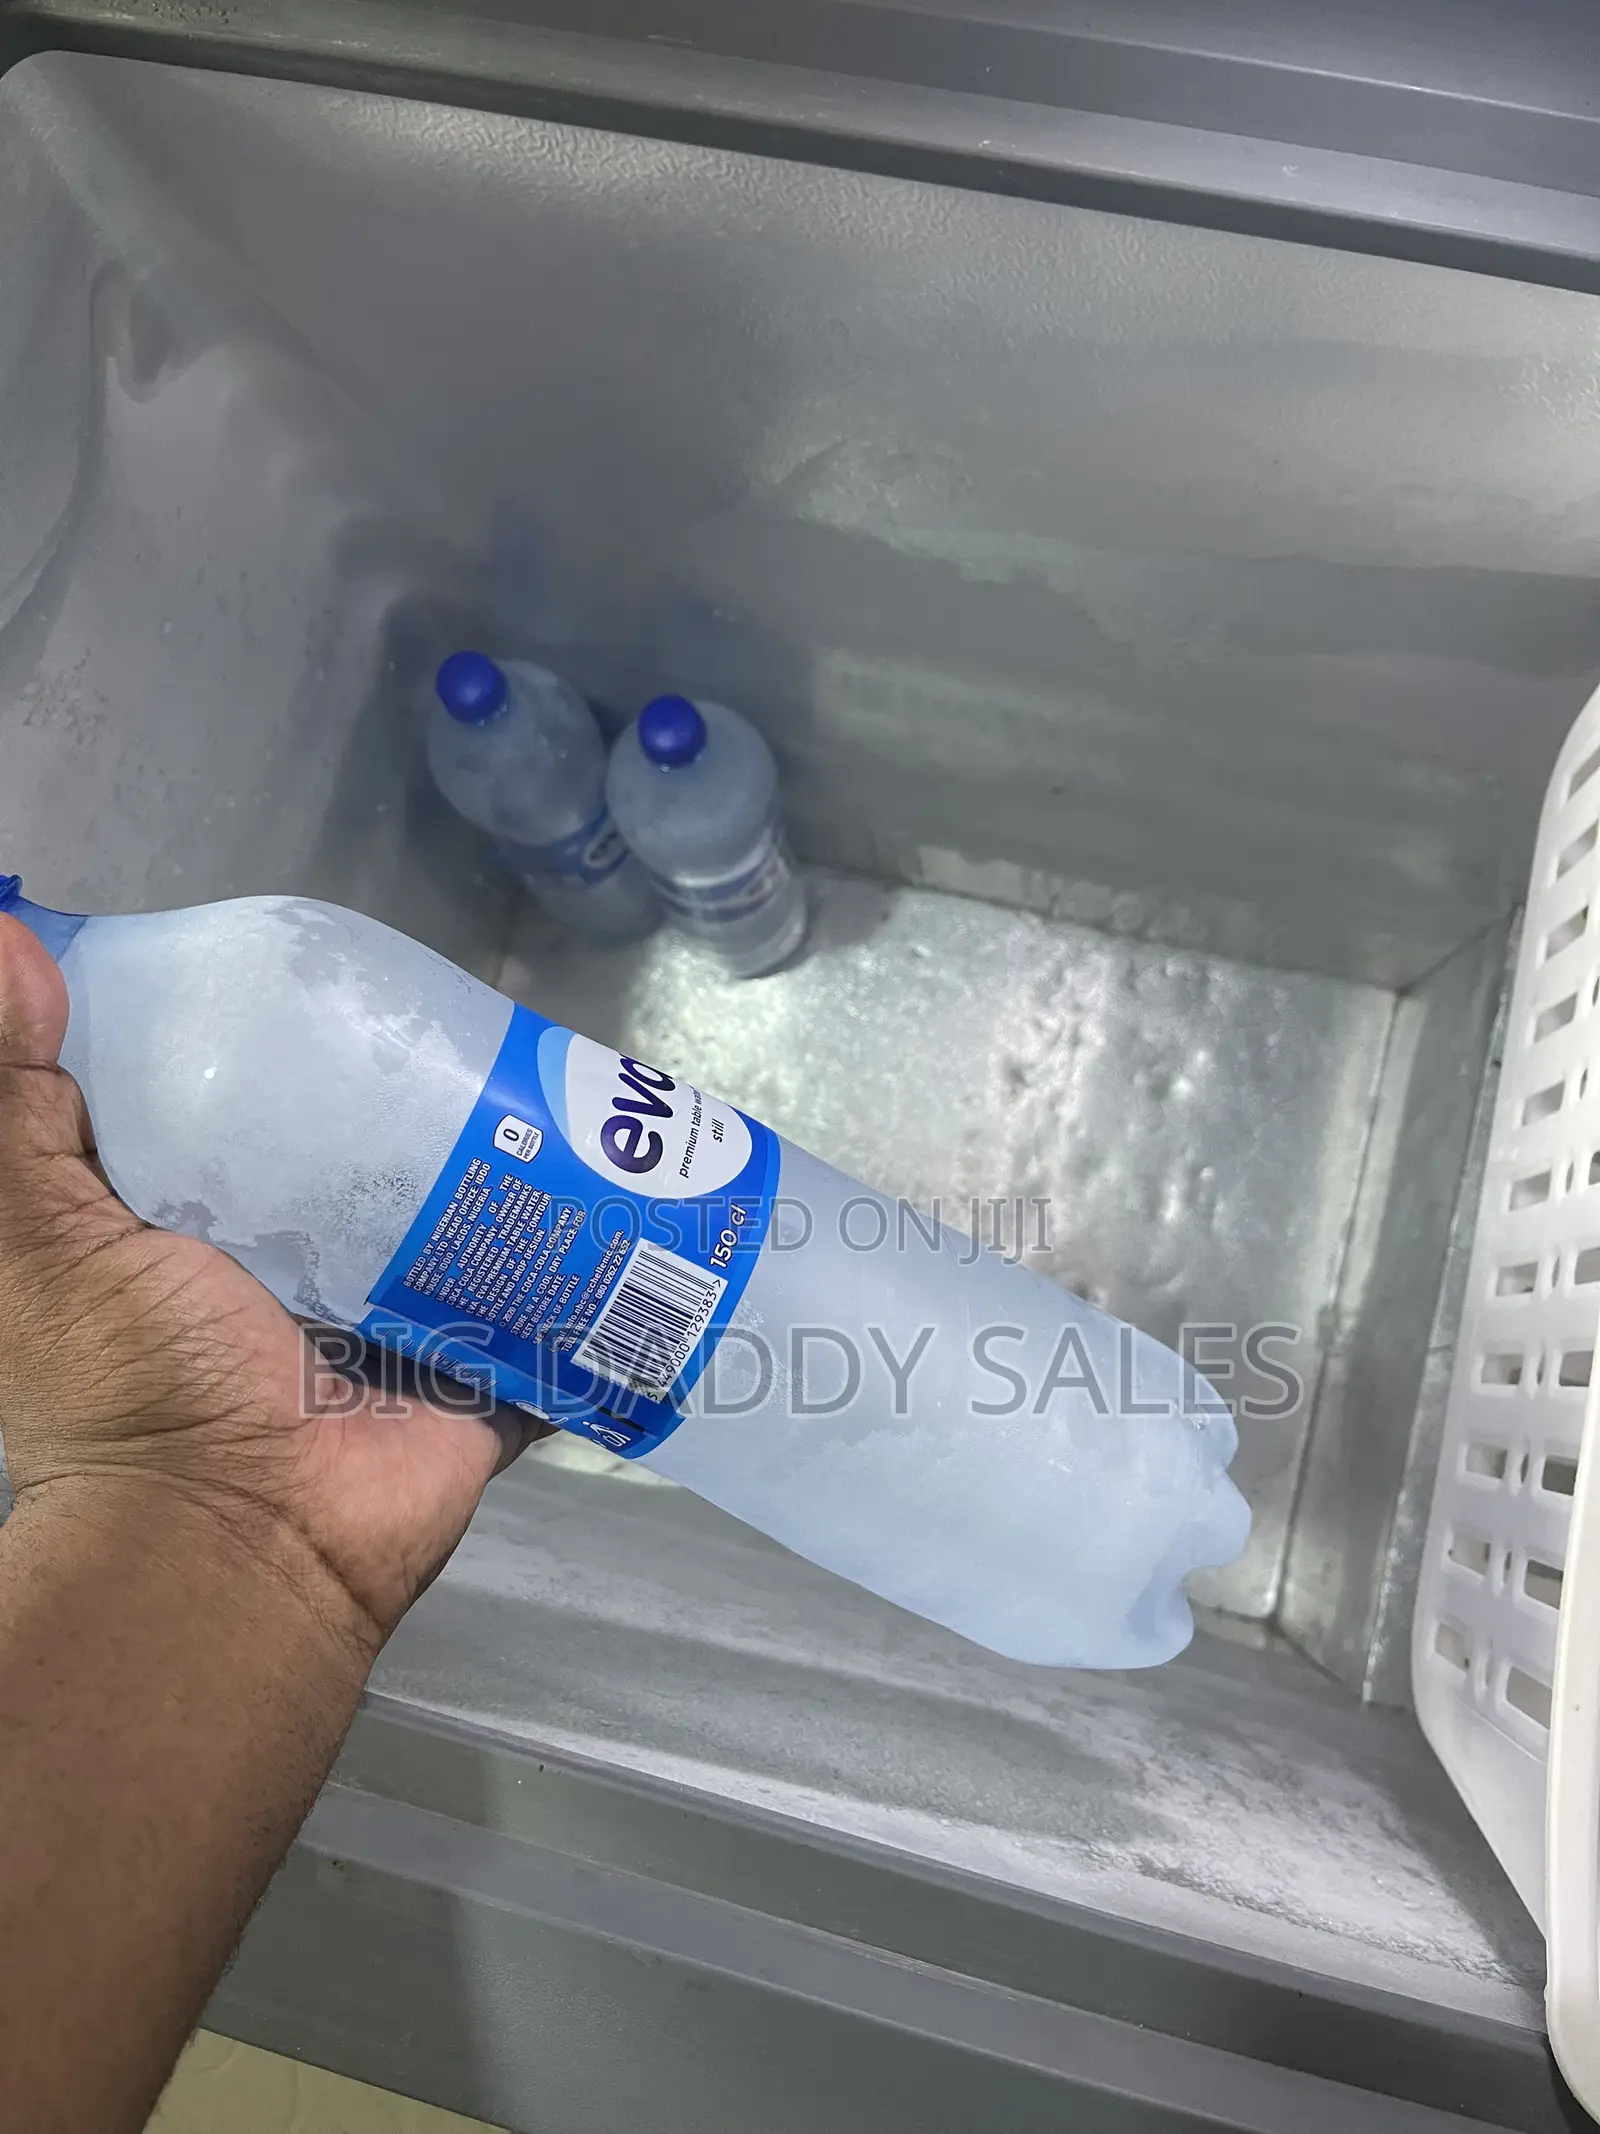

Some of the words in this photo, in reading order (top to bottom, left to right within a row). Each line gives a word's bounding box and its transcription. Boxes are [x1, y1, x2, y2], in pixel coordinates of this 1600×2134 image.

[503, 1128, 519, 1141] 0
[516, 1128, 533, 1156] CALORIES
[601, 1054, 675, 1173] eva
[679, 1127, 699, 1178] premium
[692, 1106, 702, 1127] table
[711, 1118, 724, 1142] still
[403, 1255, 427, 1288] BOTTLED
[422, 1242, 435, 1255] BY
[430, 1201, 459, 1242] NIGERIAN
[454, 1158, 482, 1200] BOTTLING
[413, 1255, 439, 1292] COMPANY
[445, 1215, 463, 1239] HEAD
[475, 1163, 491, 1185] IDDO
[495, 1191, 517, 1224] OWNER
[512, 1178, 523, 1191] OF
[709, 1228, 738, 1268] 150
[730, 1203, 747, 1226] cl
[436, 1276, 456, 1303] UNDER
[456, 1223, 488, 1269] AUTHORITY
[487, 1200, 500, 1214] OF
[499, 1173, 514, 1192] THE
[456, 1295, 469, 1311] THE
[467, 1245, 500, 1293] REGISTERED
[498, 1183, 533, 1241] TRADEMARKS
[475, 1283, 490, 1300] EVA
[485, 1246, 511, 1285] PREMIUM
[506, 1220, 526, 1247] TABLE
[476, 1304, 489, 1319] THE
[486, 1273, 508, 1302] DESIGN
[506, 1257, 517, 1270] OF
[514, 1237, 529, 1255] THE
[526, 1193, 552, 1234] CONTOUR
[510, 1312, 529, 1336] STORE
[524, 1302, 535, 1314] IN
[530, 1294, 540, 1303] A
[536, 1273, 553, 1295] COOL
[548, 1255, 563, 1273] DRY
[559, 1227, 578, 1254] PLACE
[573, 1210, 586, 1228] FOR
[485, 1297, 506, 1324] BOTTLE
[501, 1280, 516, 1299] AND
[511, 1259, 529, 1282] DROP
[512, 1291, 526, 1308] THE
[521, 1248, 551, 1293] COCA-COLA
[532, 1330, 546, 1346] SEE
[540, 1312, 557, 1334] NECK
[552, 1303, 563, 1315] OF
[558, 1274, 580, 1305] BOTTLE
[520, 1322, 535, 1341] BEST
[531, 1294, 552, 1324] BEFORE
[561, 1334, 578, 1354] TOLL
[573, 1315, 590, 1336] FREE
[647, 1392, 658, 1401] 5
[657, 1343, 691, 1387] 449000
[686, 1291, 717, 1337] 129383
